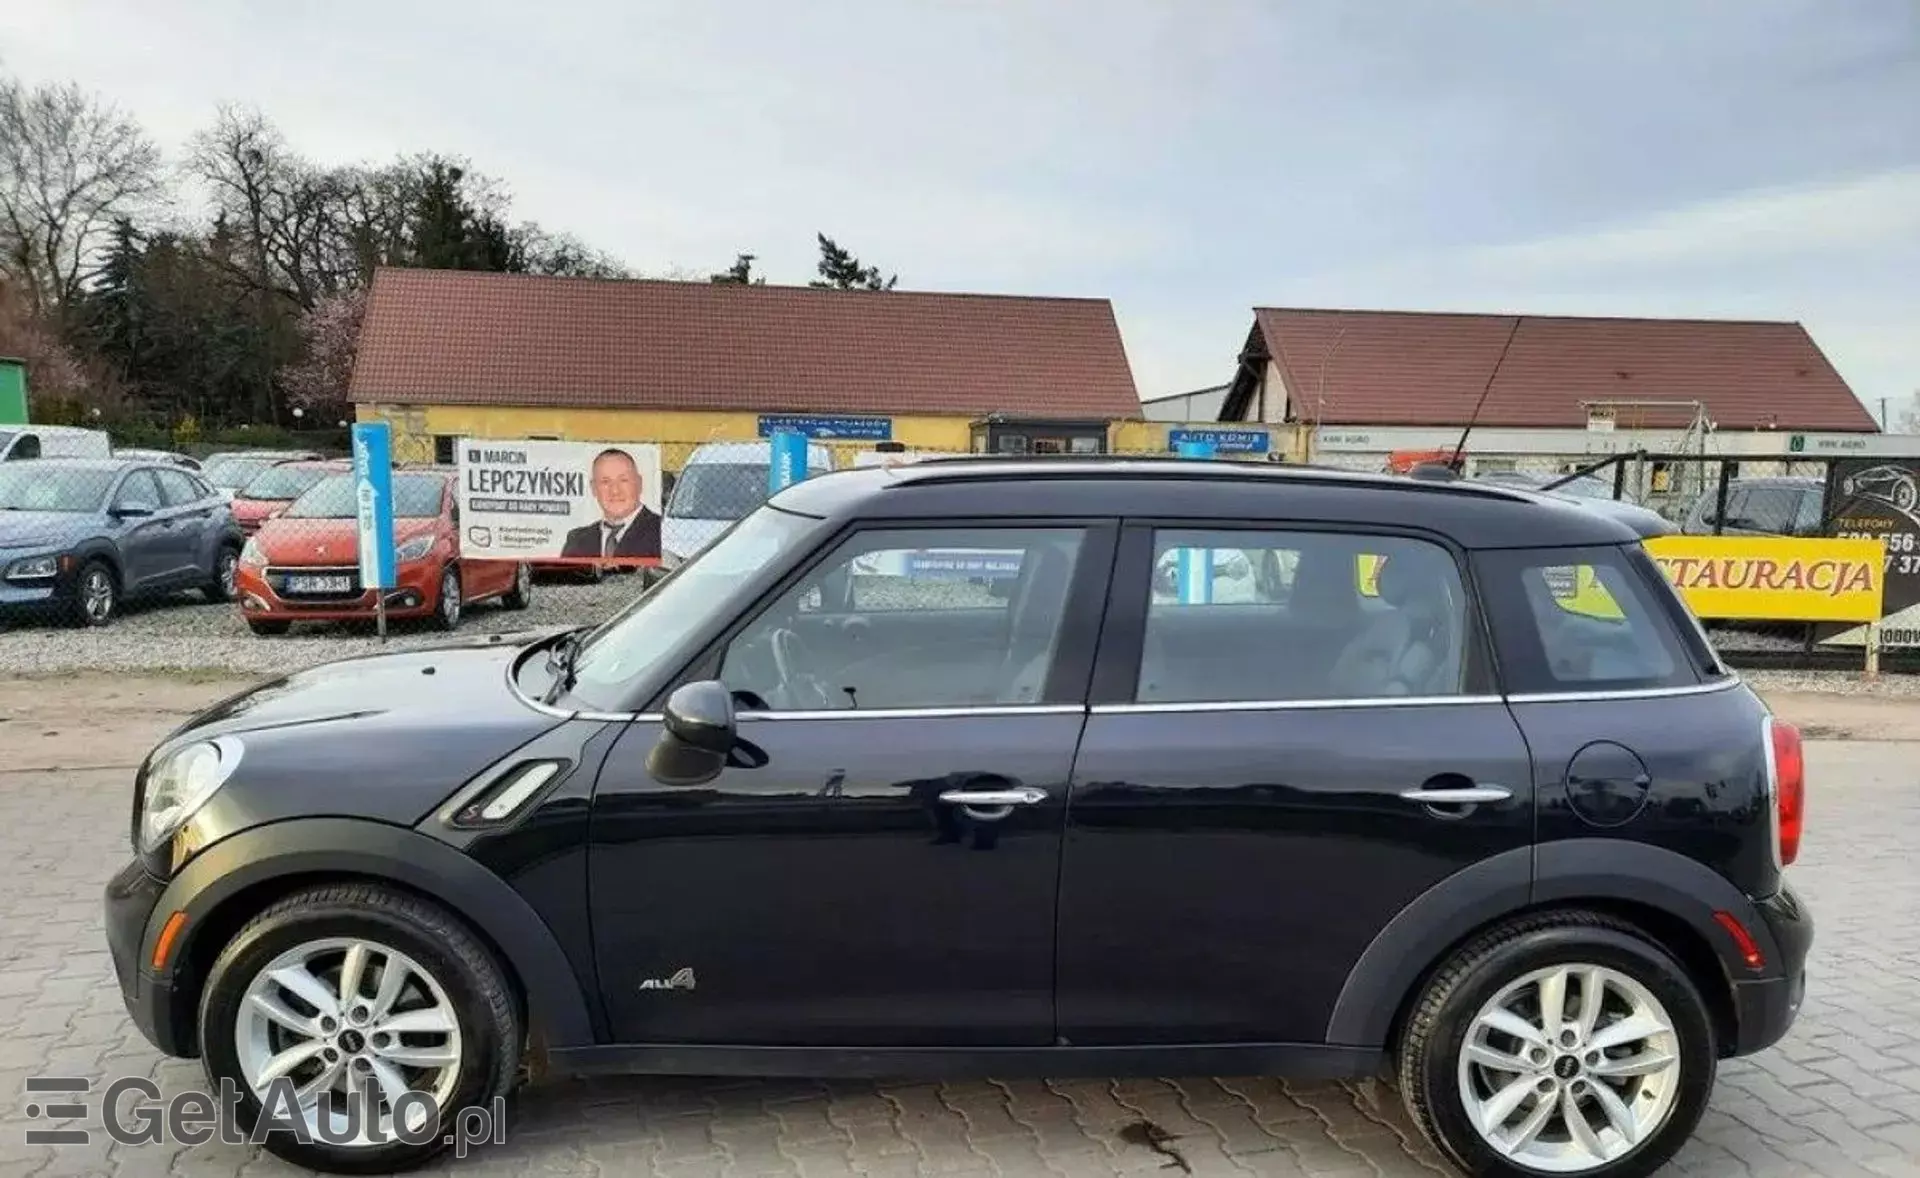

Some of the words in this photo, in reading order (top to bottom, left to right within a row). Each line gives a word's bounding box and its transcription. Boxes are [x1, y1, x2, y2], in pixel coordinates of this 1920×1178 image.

[1180, 432, 1215, 441] AUTO
[484, 450, 527, 463] MARCIN
[468, 466, 584, 497] LEPCZYŃSKI
